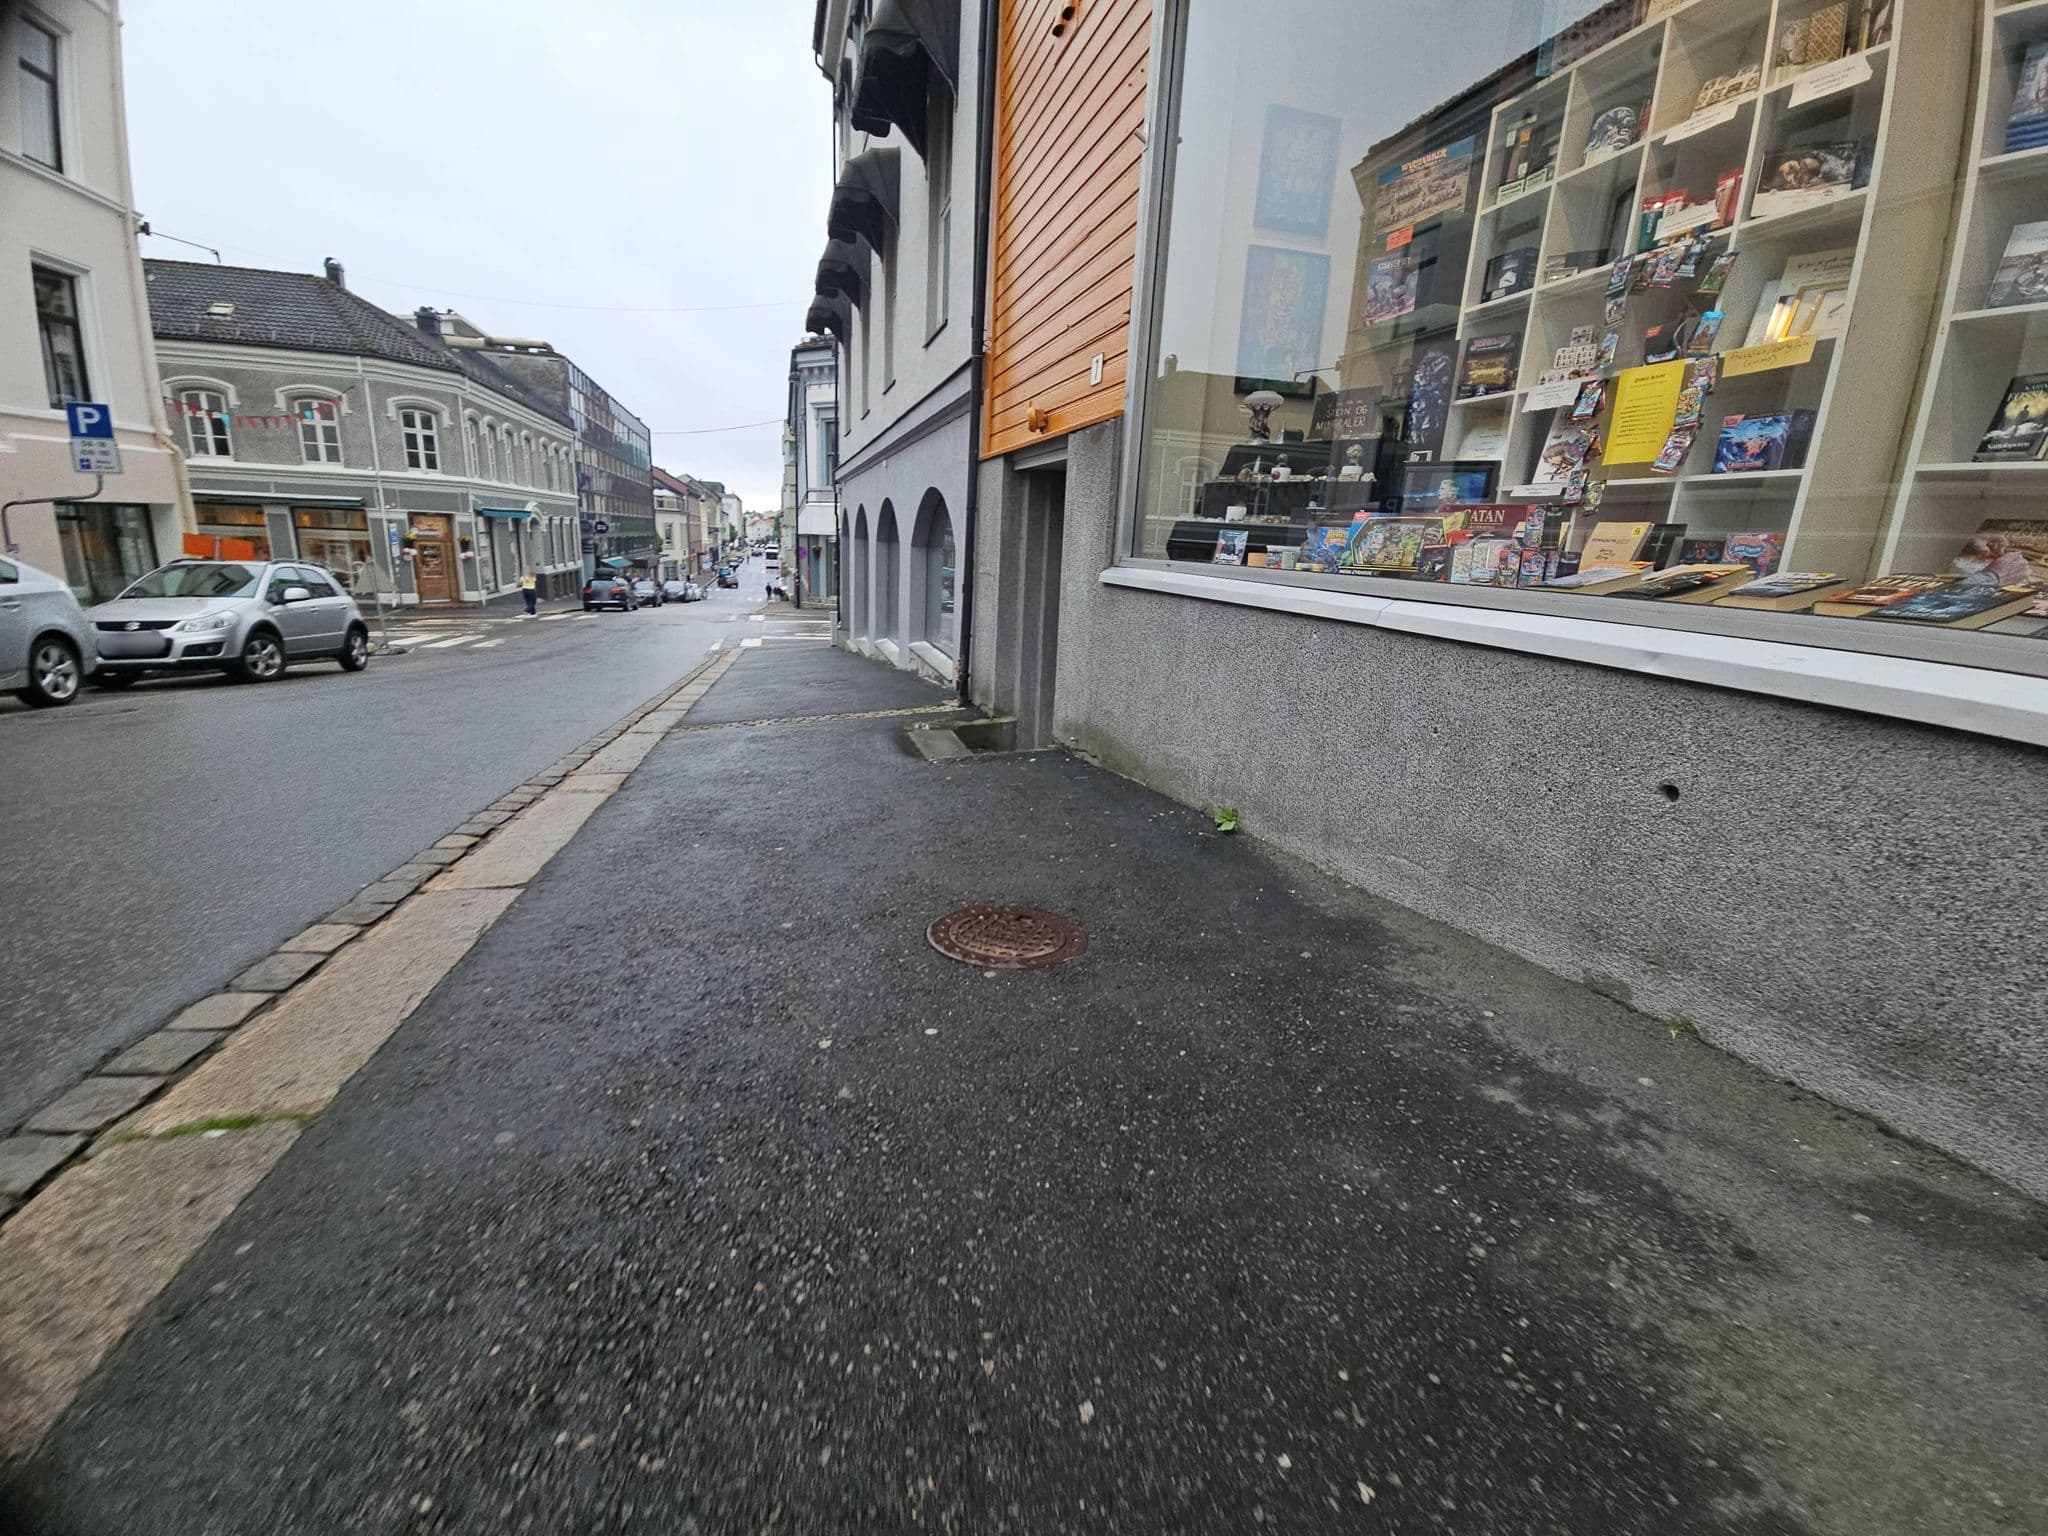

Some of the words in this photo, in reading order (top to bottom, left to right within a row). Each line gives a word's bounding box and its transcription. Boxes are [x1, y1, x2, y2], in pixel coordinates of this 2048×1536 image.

[76, 406, 101, 434] P
[1327, 407, 1351, 417] STEIN
[1355, 404, 1368, 415] OG
